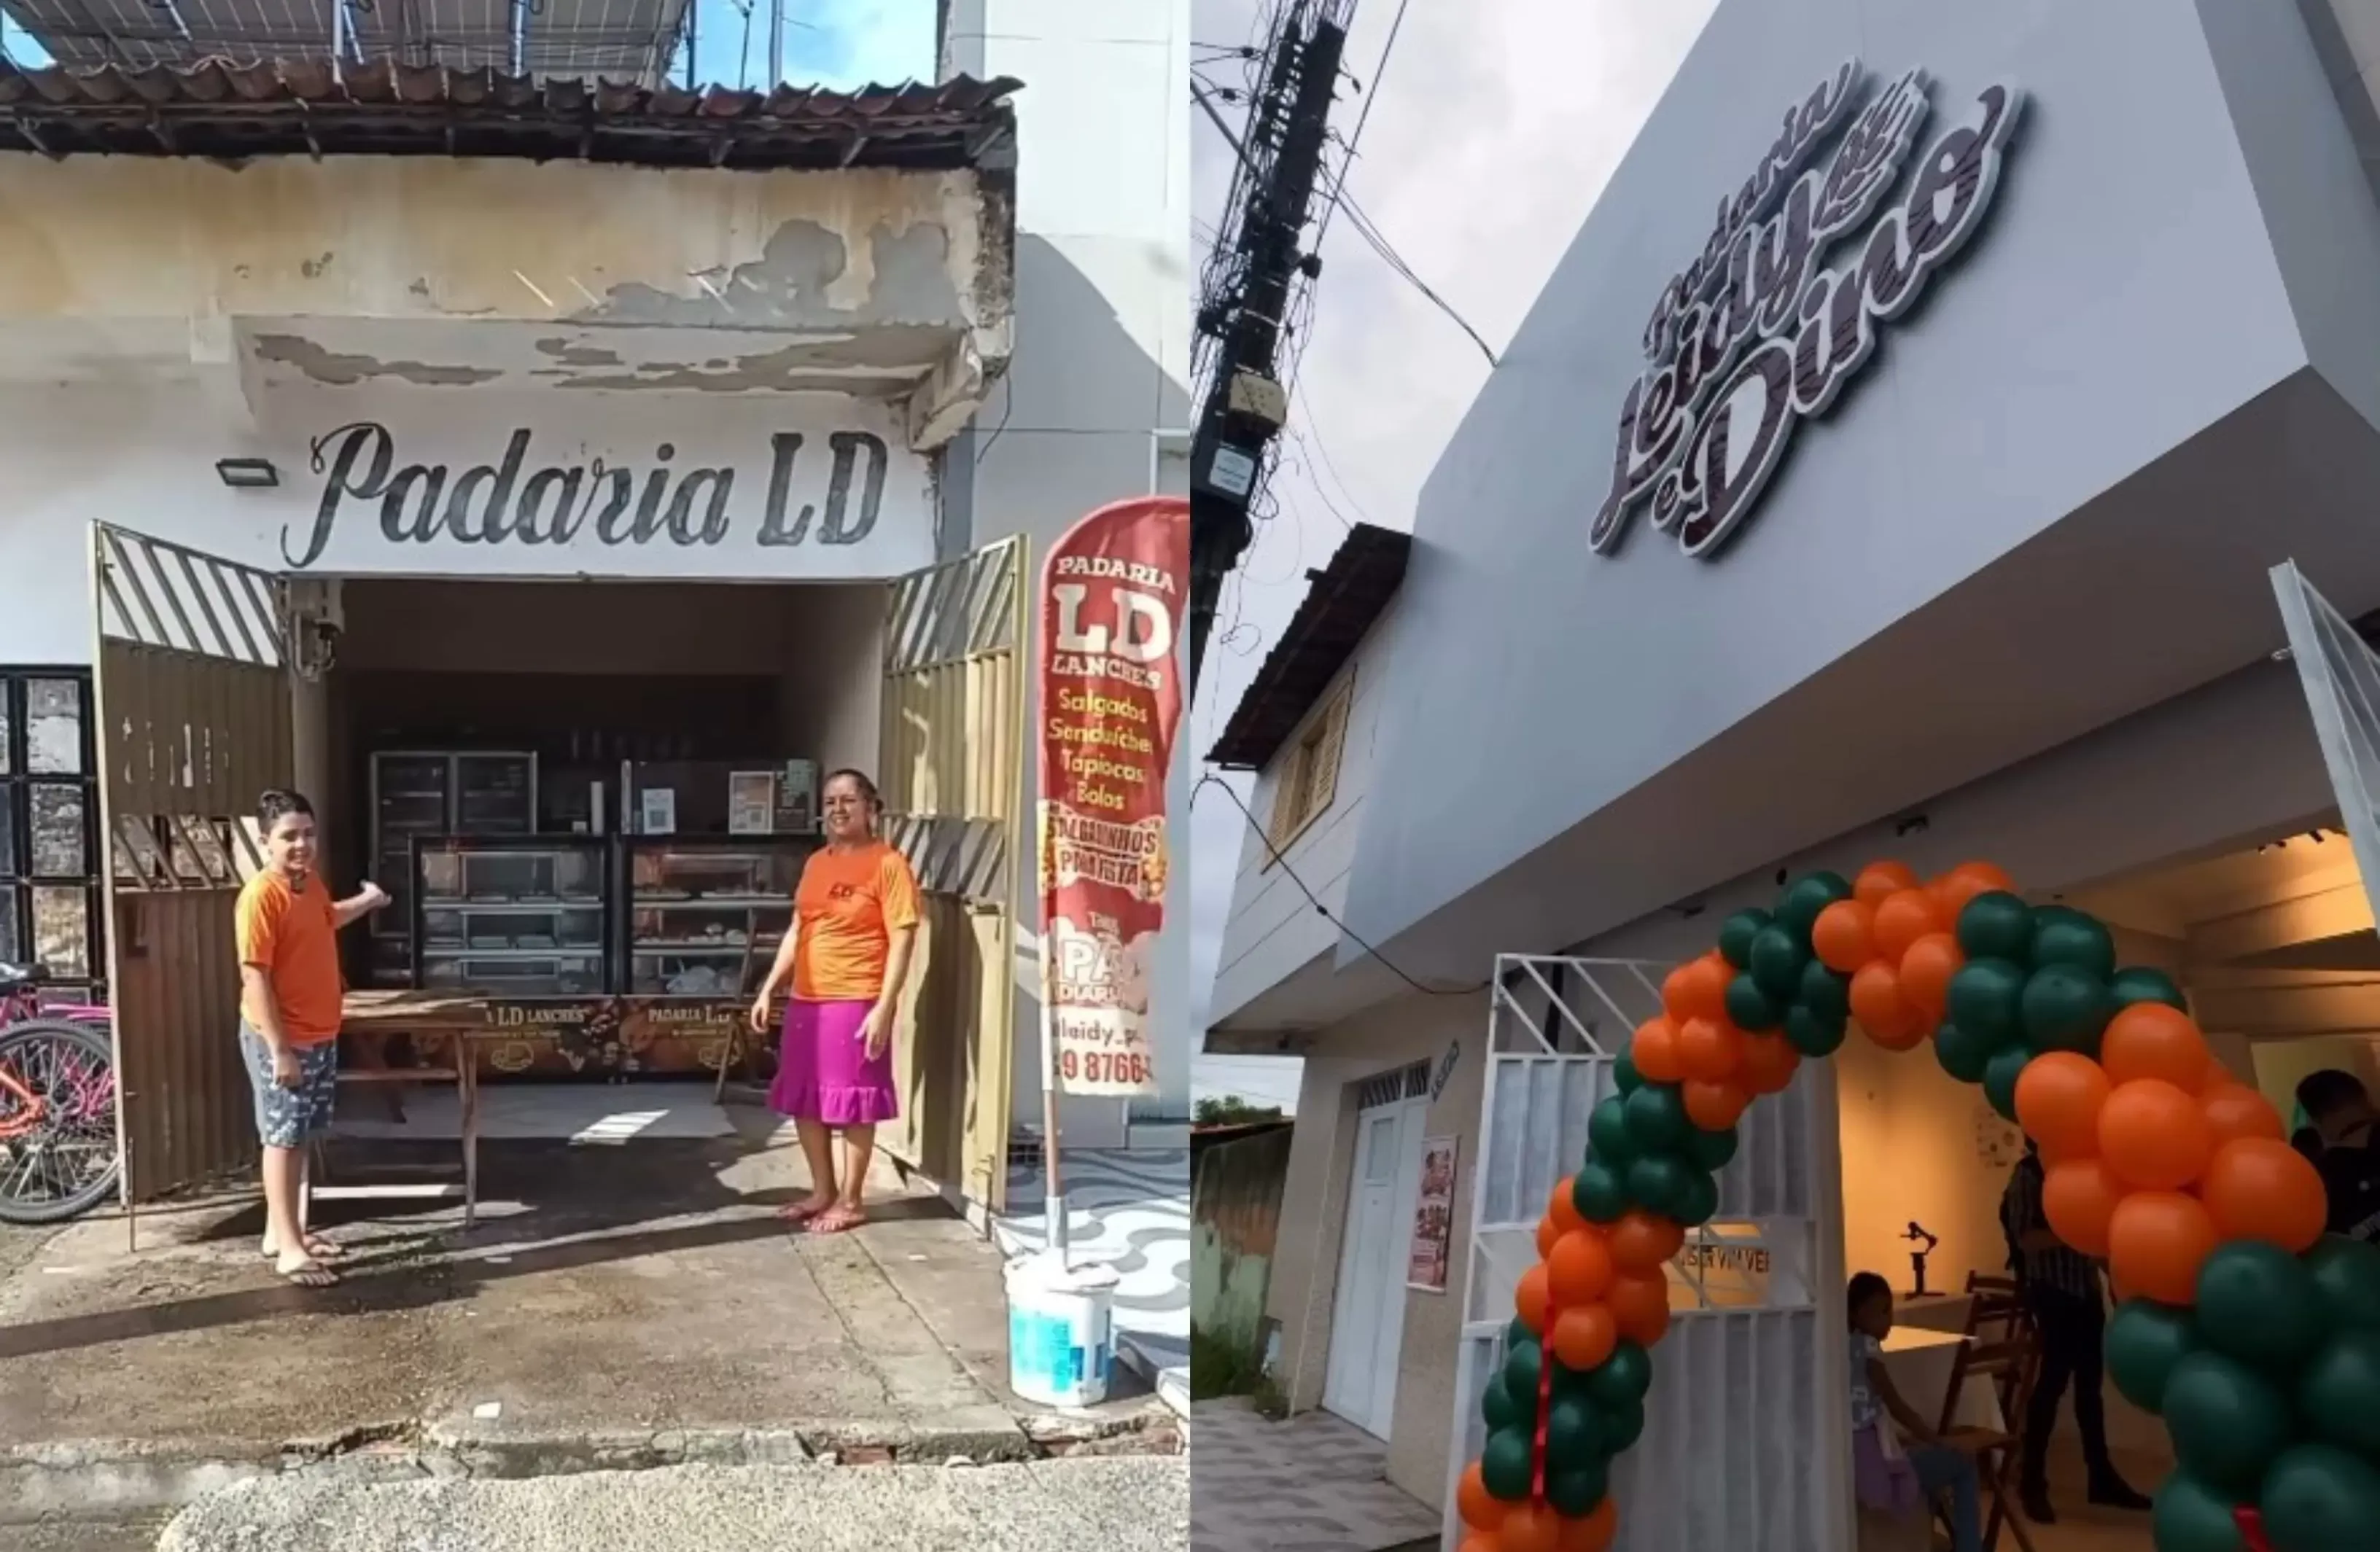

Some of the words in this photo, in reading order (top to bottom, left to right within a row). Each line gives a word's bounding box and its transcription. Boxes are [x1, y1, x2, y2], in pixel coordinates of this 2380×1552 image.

[281, 421, 734, 567] Padaria
[756, 431, 888, 547] LD
[1652, 469, 1686, 529] e
[1057, 555, 1175, 595] PADARIA
[1051, 584, 1171, 663] LD
[1051, 654, 1162, 691] LANCHES
[1058, 687, 1148, 723] Salgados
[1061, 748, 1145, 782] Tapiocas
[1076, 779, 1125, 810] Bolos
[497, 1006, 525, 1026] LD
